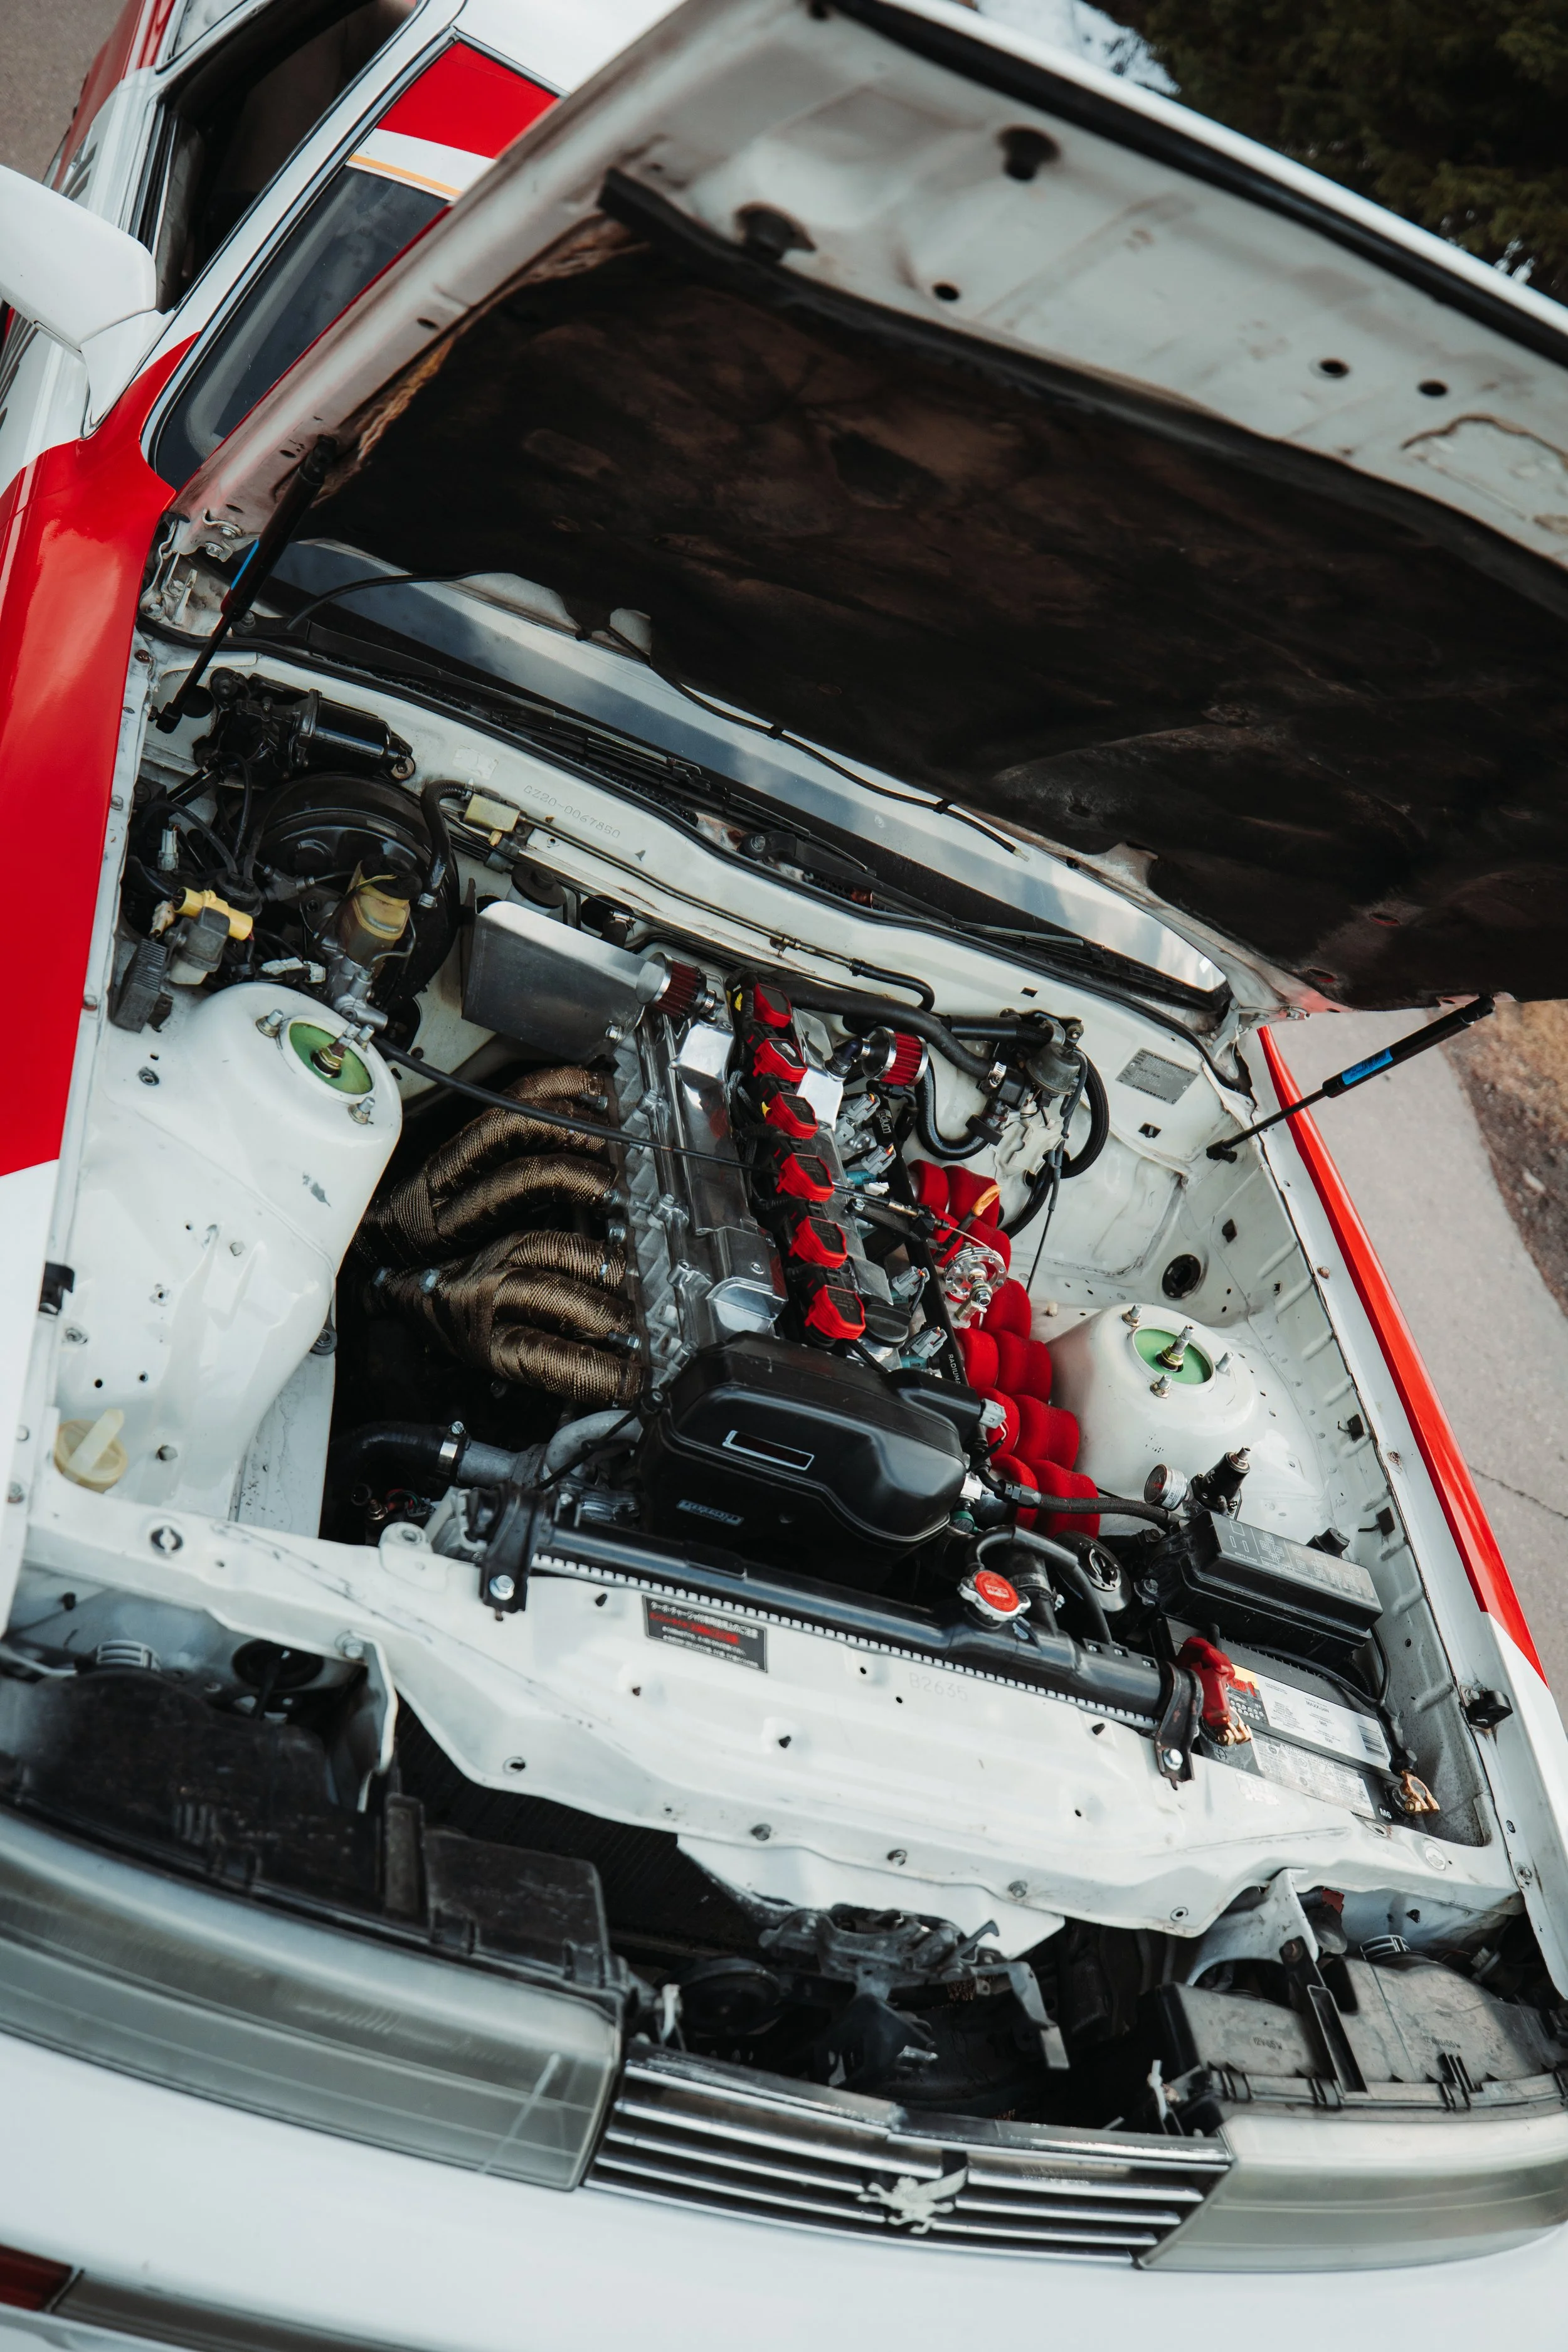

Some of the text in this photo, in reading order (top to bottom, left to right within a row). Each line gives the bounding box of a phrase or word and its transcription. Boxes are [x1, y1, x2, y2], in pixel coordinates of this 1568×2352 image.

[1167, 1061, 1190, 1073] CORPORATION
[909, 1671, 968, 1702] B2635
[1379, 1807, 1392, 1819] M6
